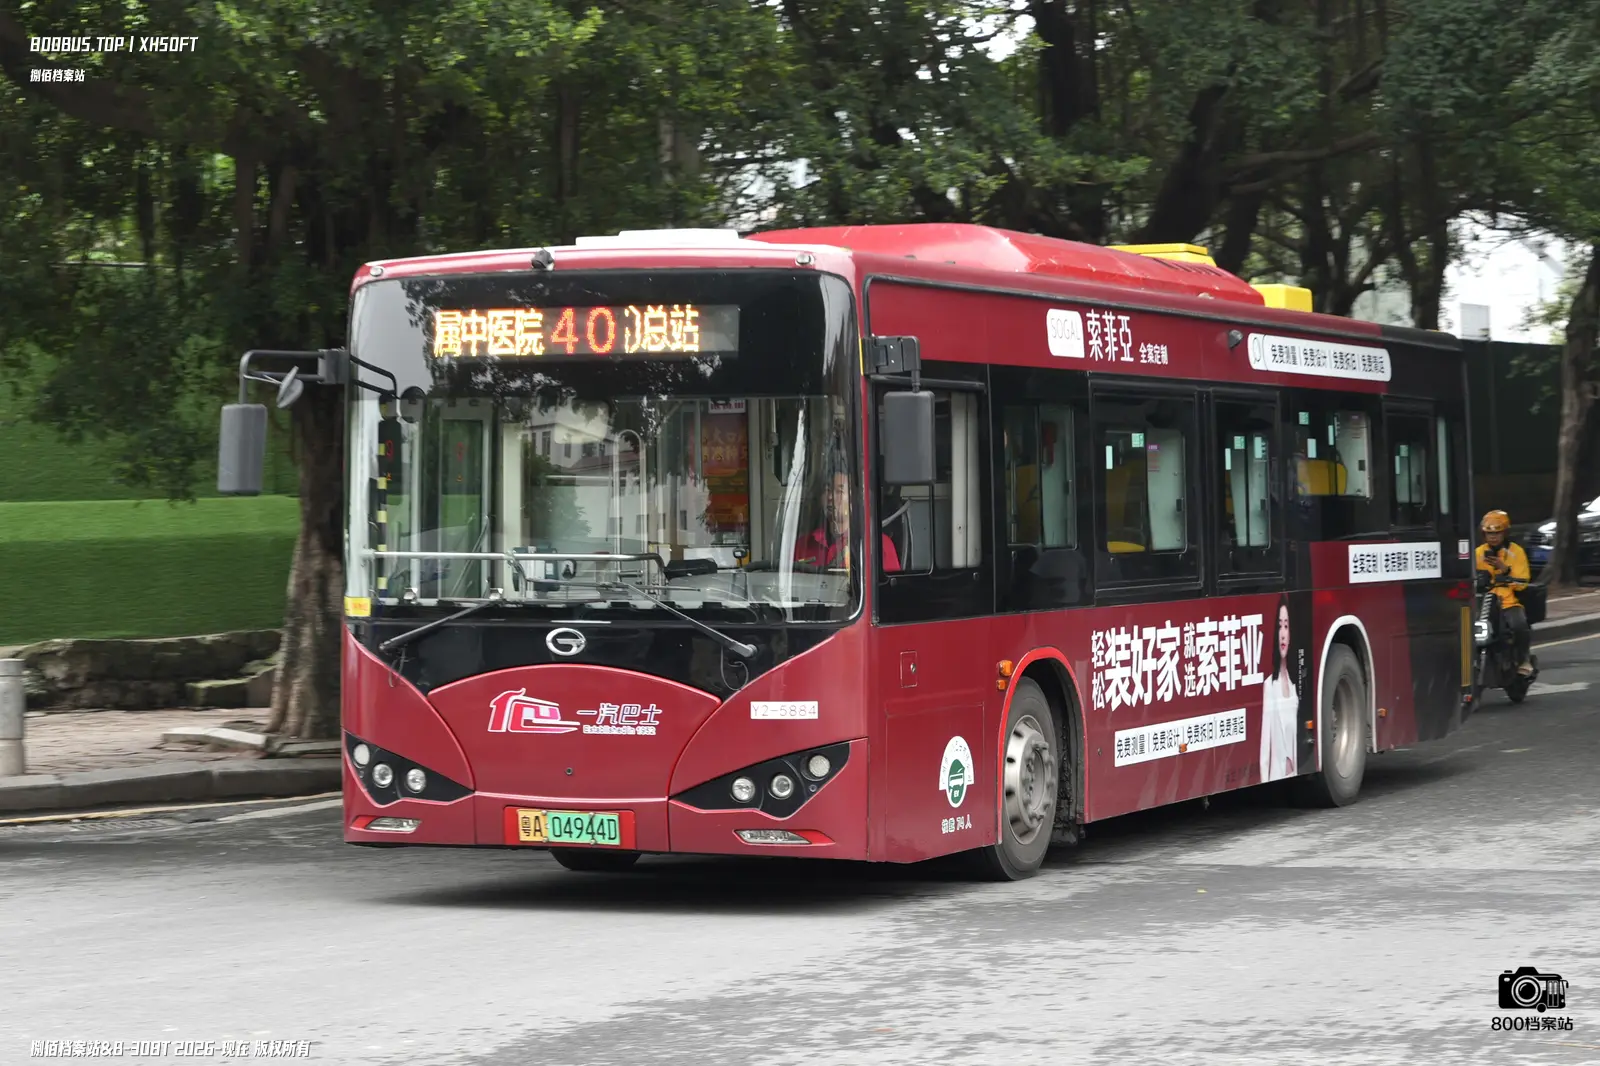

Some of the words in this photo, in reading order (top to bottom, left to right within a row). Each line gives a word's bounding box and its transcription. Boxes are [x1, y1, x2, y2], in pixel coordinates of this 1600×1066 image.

[551, 307, 616, 355] 40
[576, 702, 663, 726] 一汽巴士
[752, 703, 818, 718] Y2-5884
